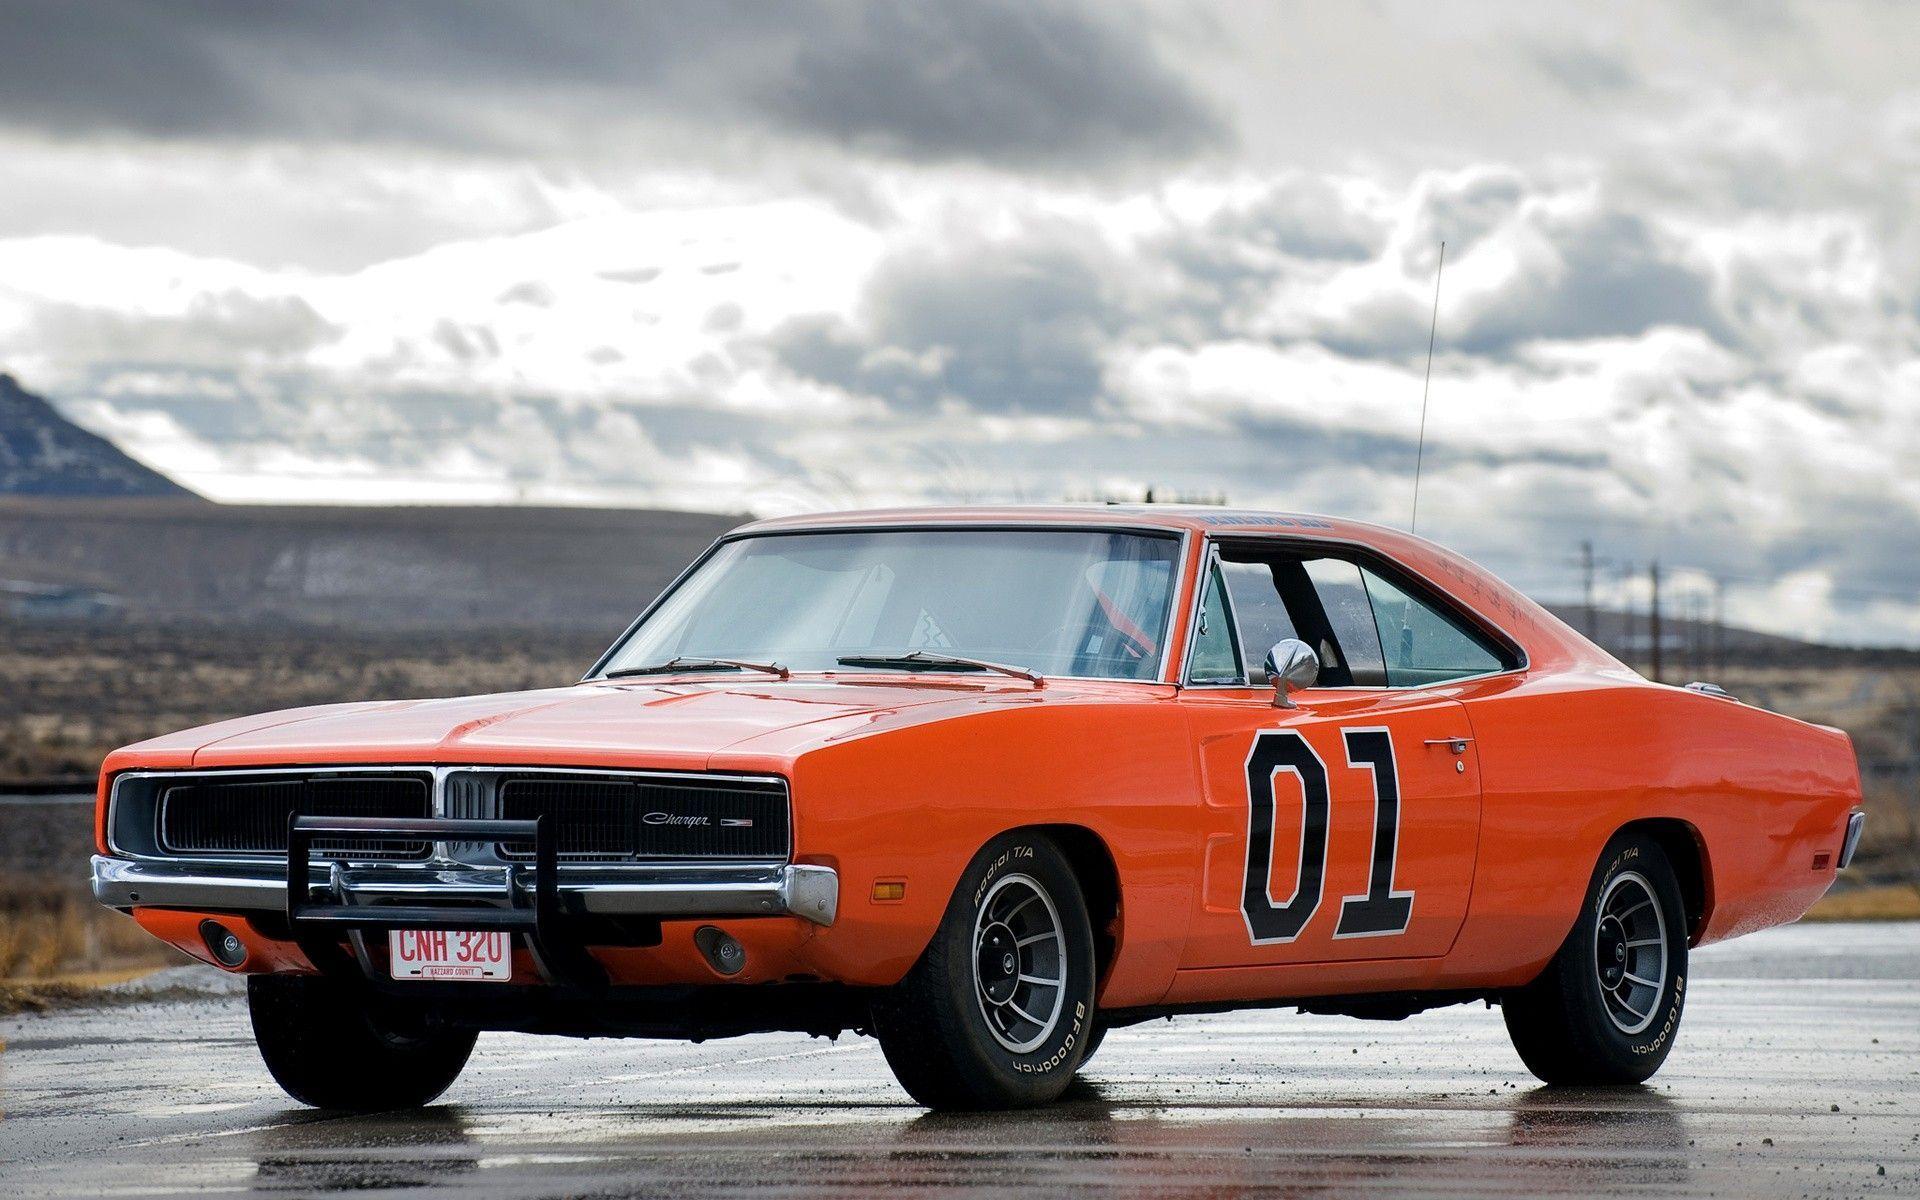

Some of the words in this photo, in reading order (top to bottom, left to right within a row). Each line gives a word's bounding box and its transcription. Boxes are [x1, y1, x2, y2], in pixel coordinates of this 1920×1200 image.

[643, 812, 711, 828] Charger
[1240, 726, 1415, 946] 01
[1623, 847, 1639, 860] T/A
[974, 850, 1009, 908] Radial
[1013, 846, 1033, 858] T/A
[400, 930, 447, 962] CNH
[455, 931, 502, 963] 320
